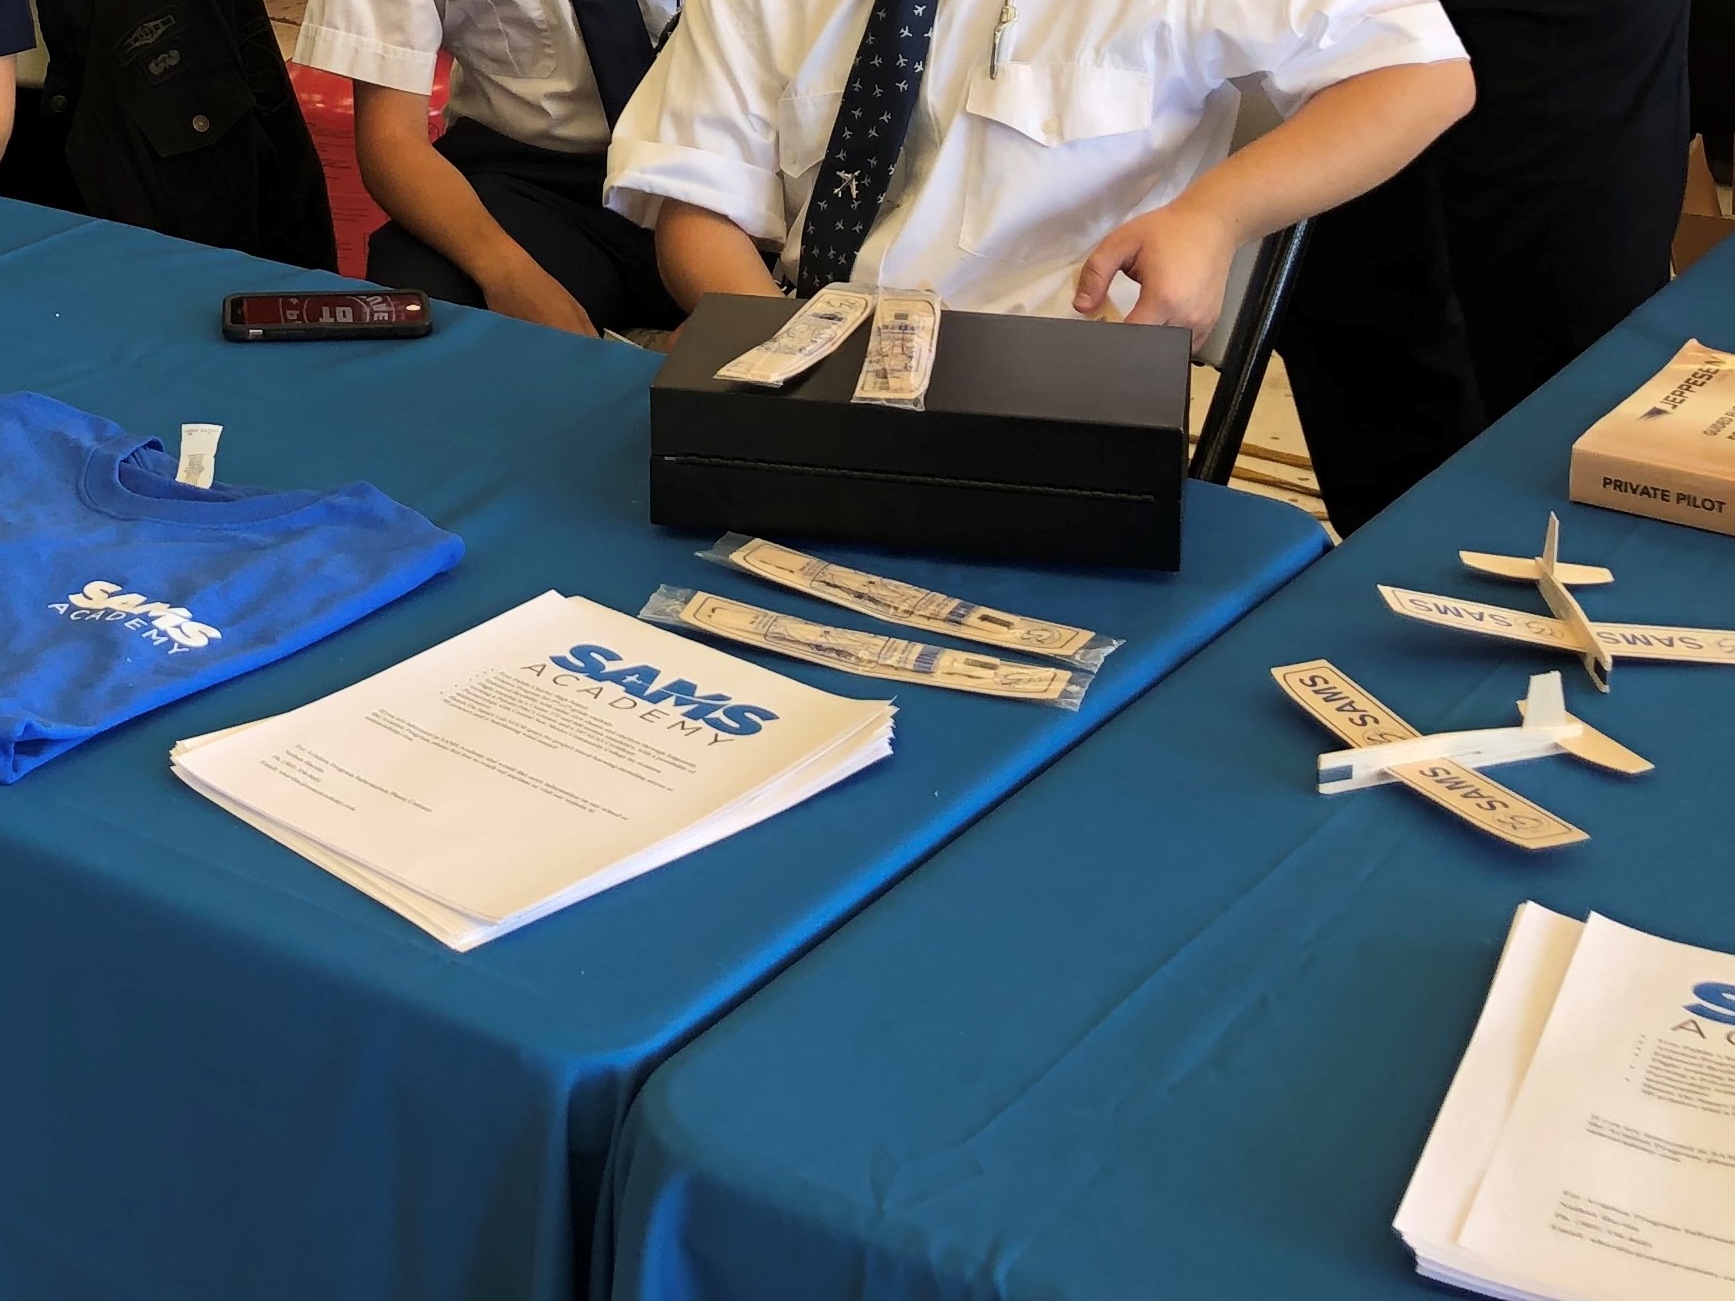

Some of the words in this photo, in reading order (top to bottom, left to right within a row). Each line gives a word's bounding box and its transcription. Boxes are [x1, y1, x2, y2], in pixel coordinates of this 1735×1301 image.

[1660, 356, 1726, 410] JEPPESEN
[1602, 476, 1671, 502] PRIVATE
[1676, 491, 1727, 514] PILOT
[48, 602, 190, 655] ACADEMY
[68, 580, 222, 648] SAMS
[1409, 598, 1513, 628] SAMS
[1597, 630, 1704, 651] SAMS
[520, 662, 734, 747] ACADEMY
[549, 643, 780, 736] SAMS
[1299, 674, 1380, 728] SAMS
[1419, 765, 1509, 812] SAMS
